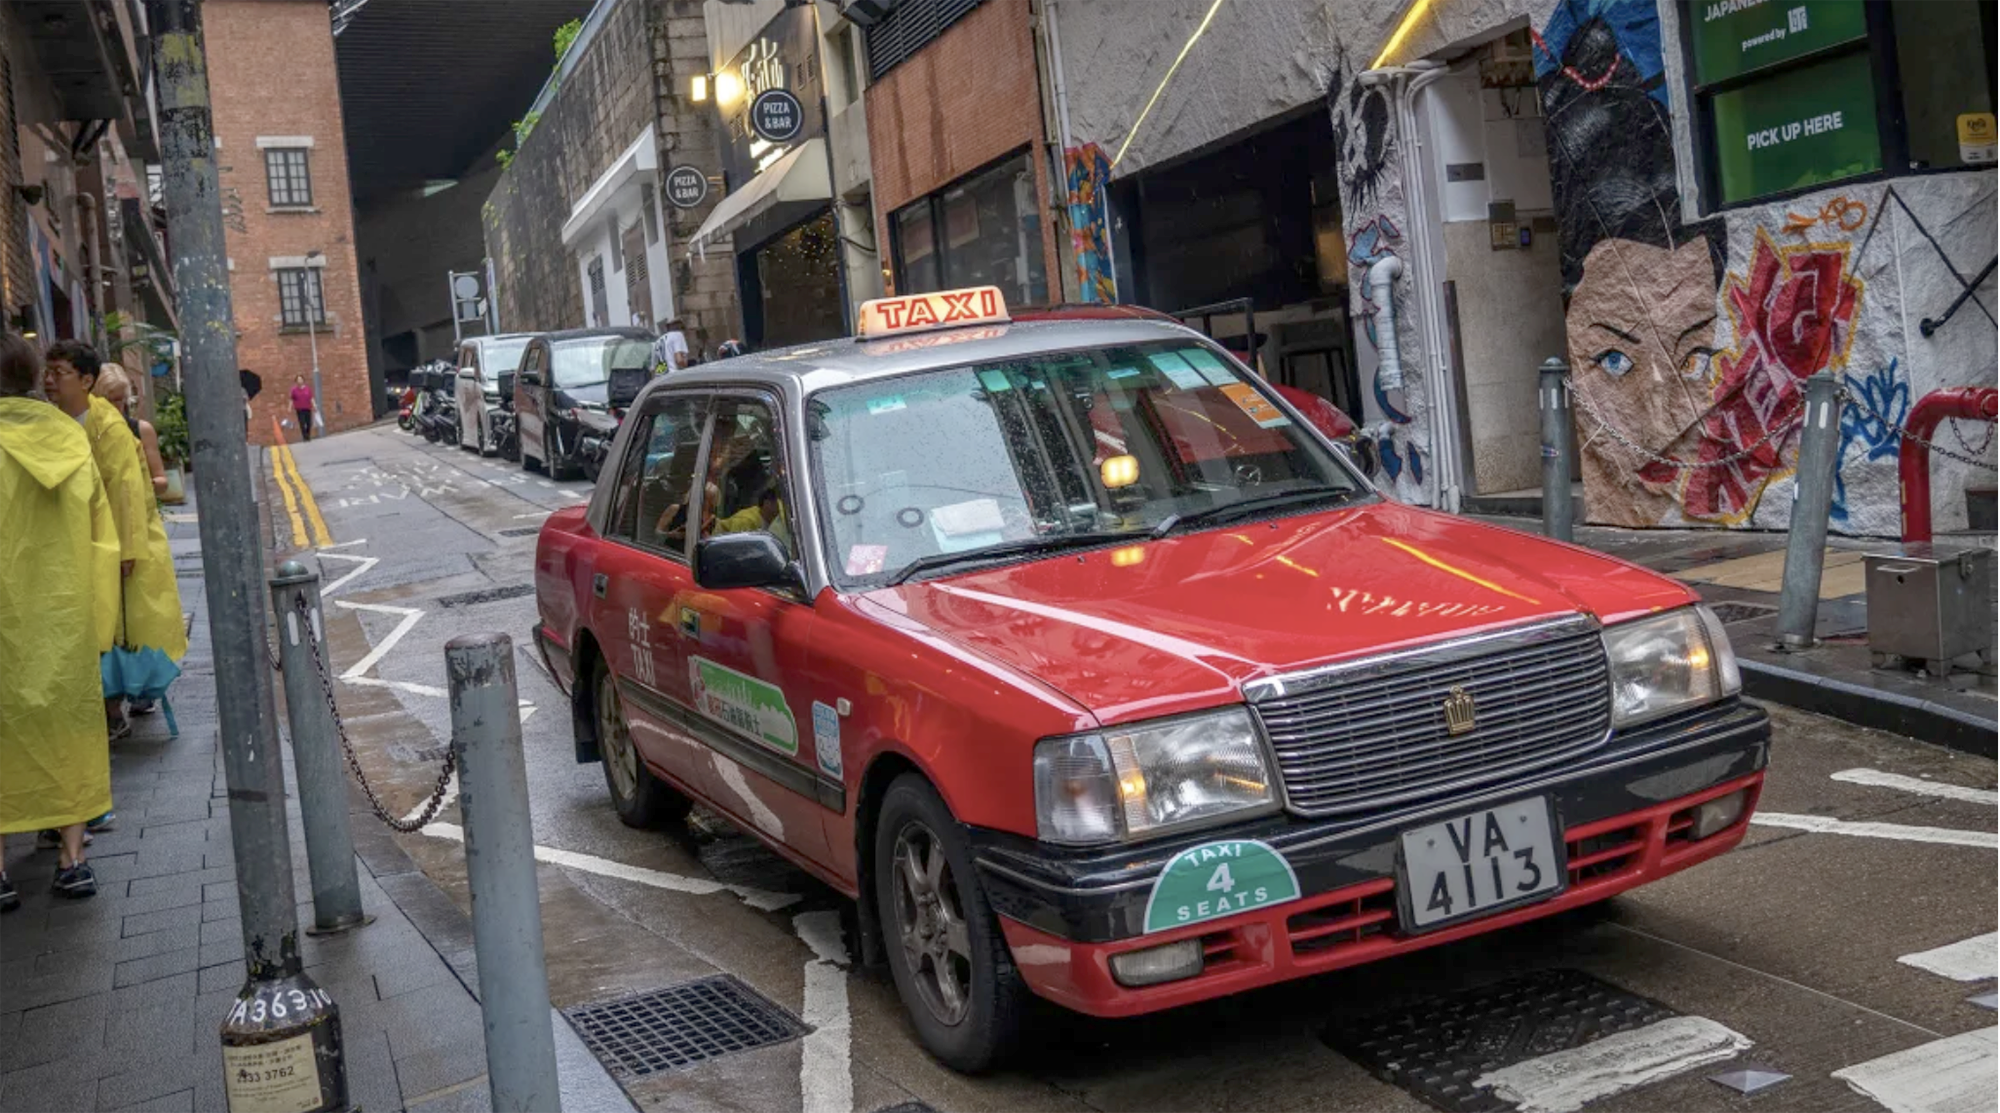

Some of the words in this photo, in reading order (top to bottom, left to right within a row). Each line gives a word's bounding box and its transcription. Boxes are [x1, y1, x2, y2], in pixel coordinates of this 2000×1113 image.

[1742, 29, 1775, 52] powered
[1775, 27, 1786, 39] by
[763, 102, 790, 114] PIZZA
[1747, 128, 1780, 150] PICK
[1782, 123, 1801, 141] UP
[1804, 111, 1843, 136] HERE
[673, 174, 697, 187] PIZZA
[876, 289, 997, 330] TAXI
[628, 607, 650, 648] 的士
[630, 643, 657, 687] TAXI
[1445, 811, 1509, 864] VA
[1184, 843, 1242, 868] TAXI
[1206, 862, 1235, 893] 4
[1426, 846, 1542, 915] 4113
[1177, 886, 1268, 921] SEATS
[265, 1065, 295, 1081] 3762
